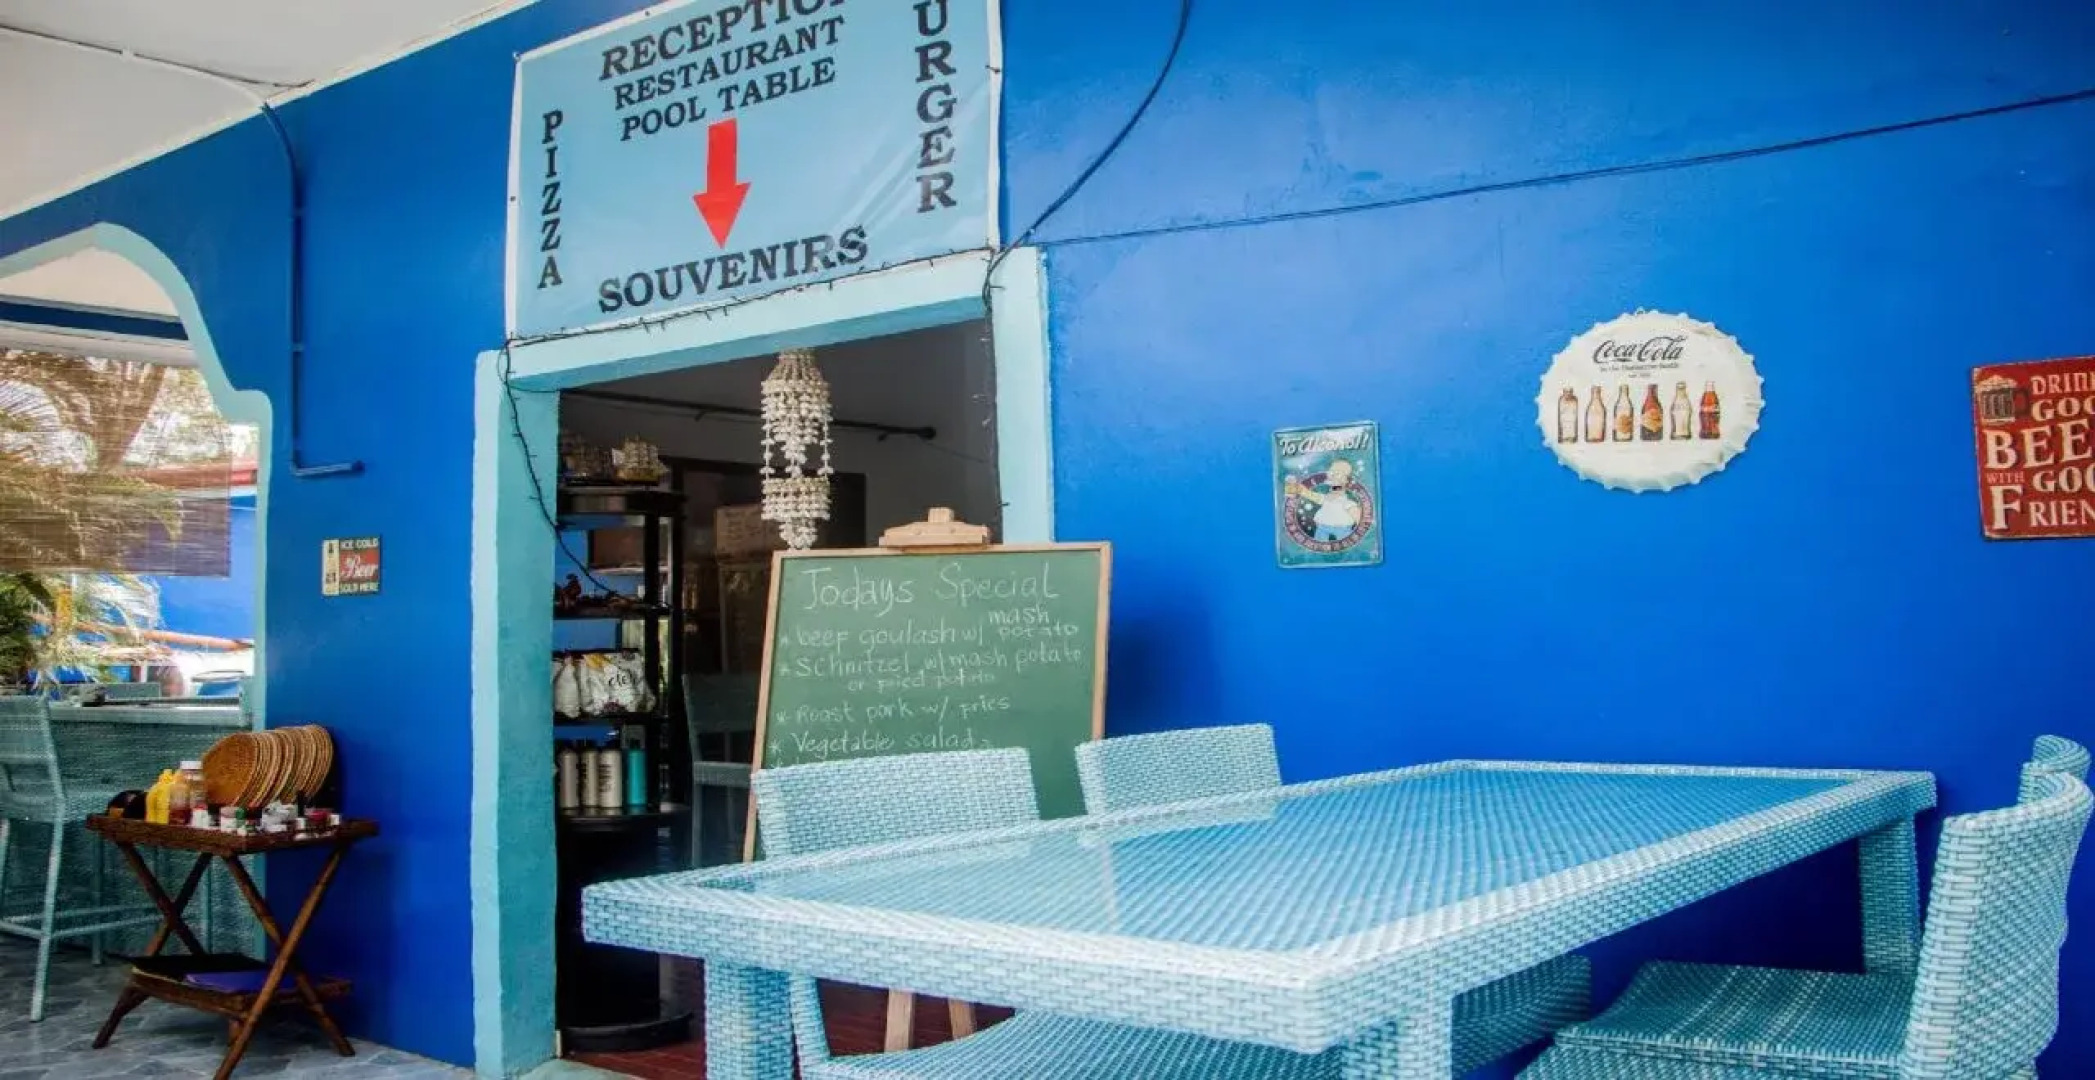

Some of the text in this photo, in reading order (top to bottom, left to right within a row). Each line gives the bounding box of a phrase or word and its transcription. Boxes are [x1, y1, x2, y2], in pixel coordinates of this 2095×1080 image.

[599, 0, 845, 81] RECEPTI
[613, 15, 845, 110] RESTAURANT
[620, 56, 836, 141] POOL TABLE
[537, 109, 563, 289] PIZZA
[598, 225, 868, 313] SOUVENIRS
[1986, 471, 2025, 484] WITH
[934, 562, 1060, 608] Special
[859, 616, 955, 652] goulash
[988, 602, 1050, 625] mash
[1016, 640, 1081, 674] potato
